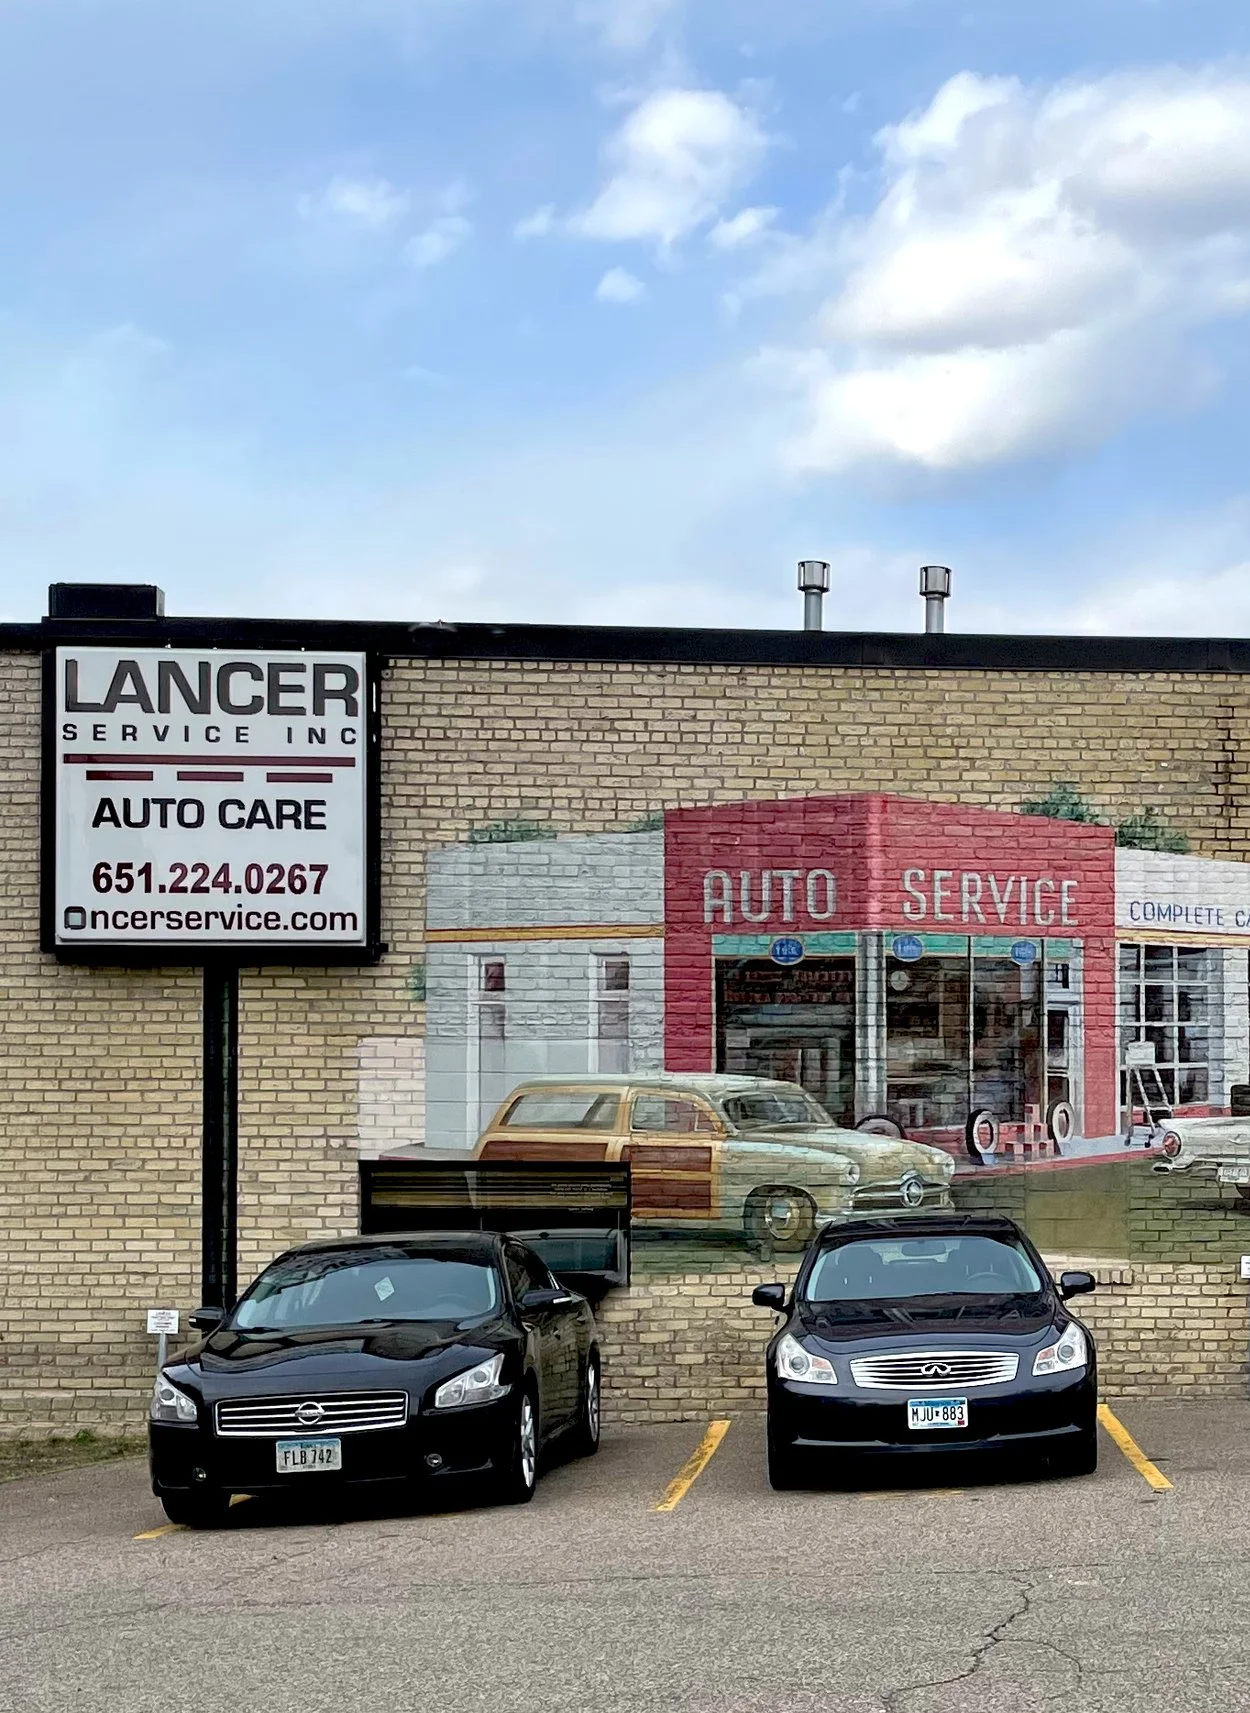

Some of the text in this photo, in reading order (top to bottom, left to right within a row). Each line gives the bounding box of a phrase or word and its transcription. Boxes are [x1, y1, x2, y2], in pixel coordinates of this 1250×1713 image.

[64, 658, 360, 718] LANCER
[62, 723, 357, 745] SERVICE INC
[92, 797, 328, 831] AUTO CARE
[92, 861, 329, 895] 651.224.0267
[702, 867, 1079, 926] AUTO SERVICE
[1129, 901, 1225, 927] COMPLETE
[311, 1448, 332, 1464] 742
